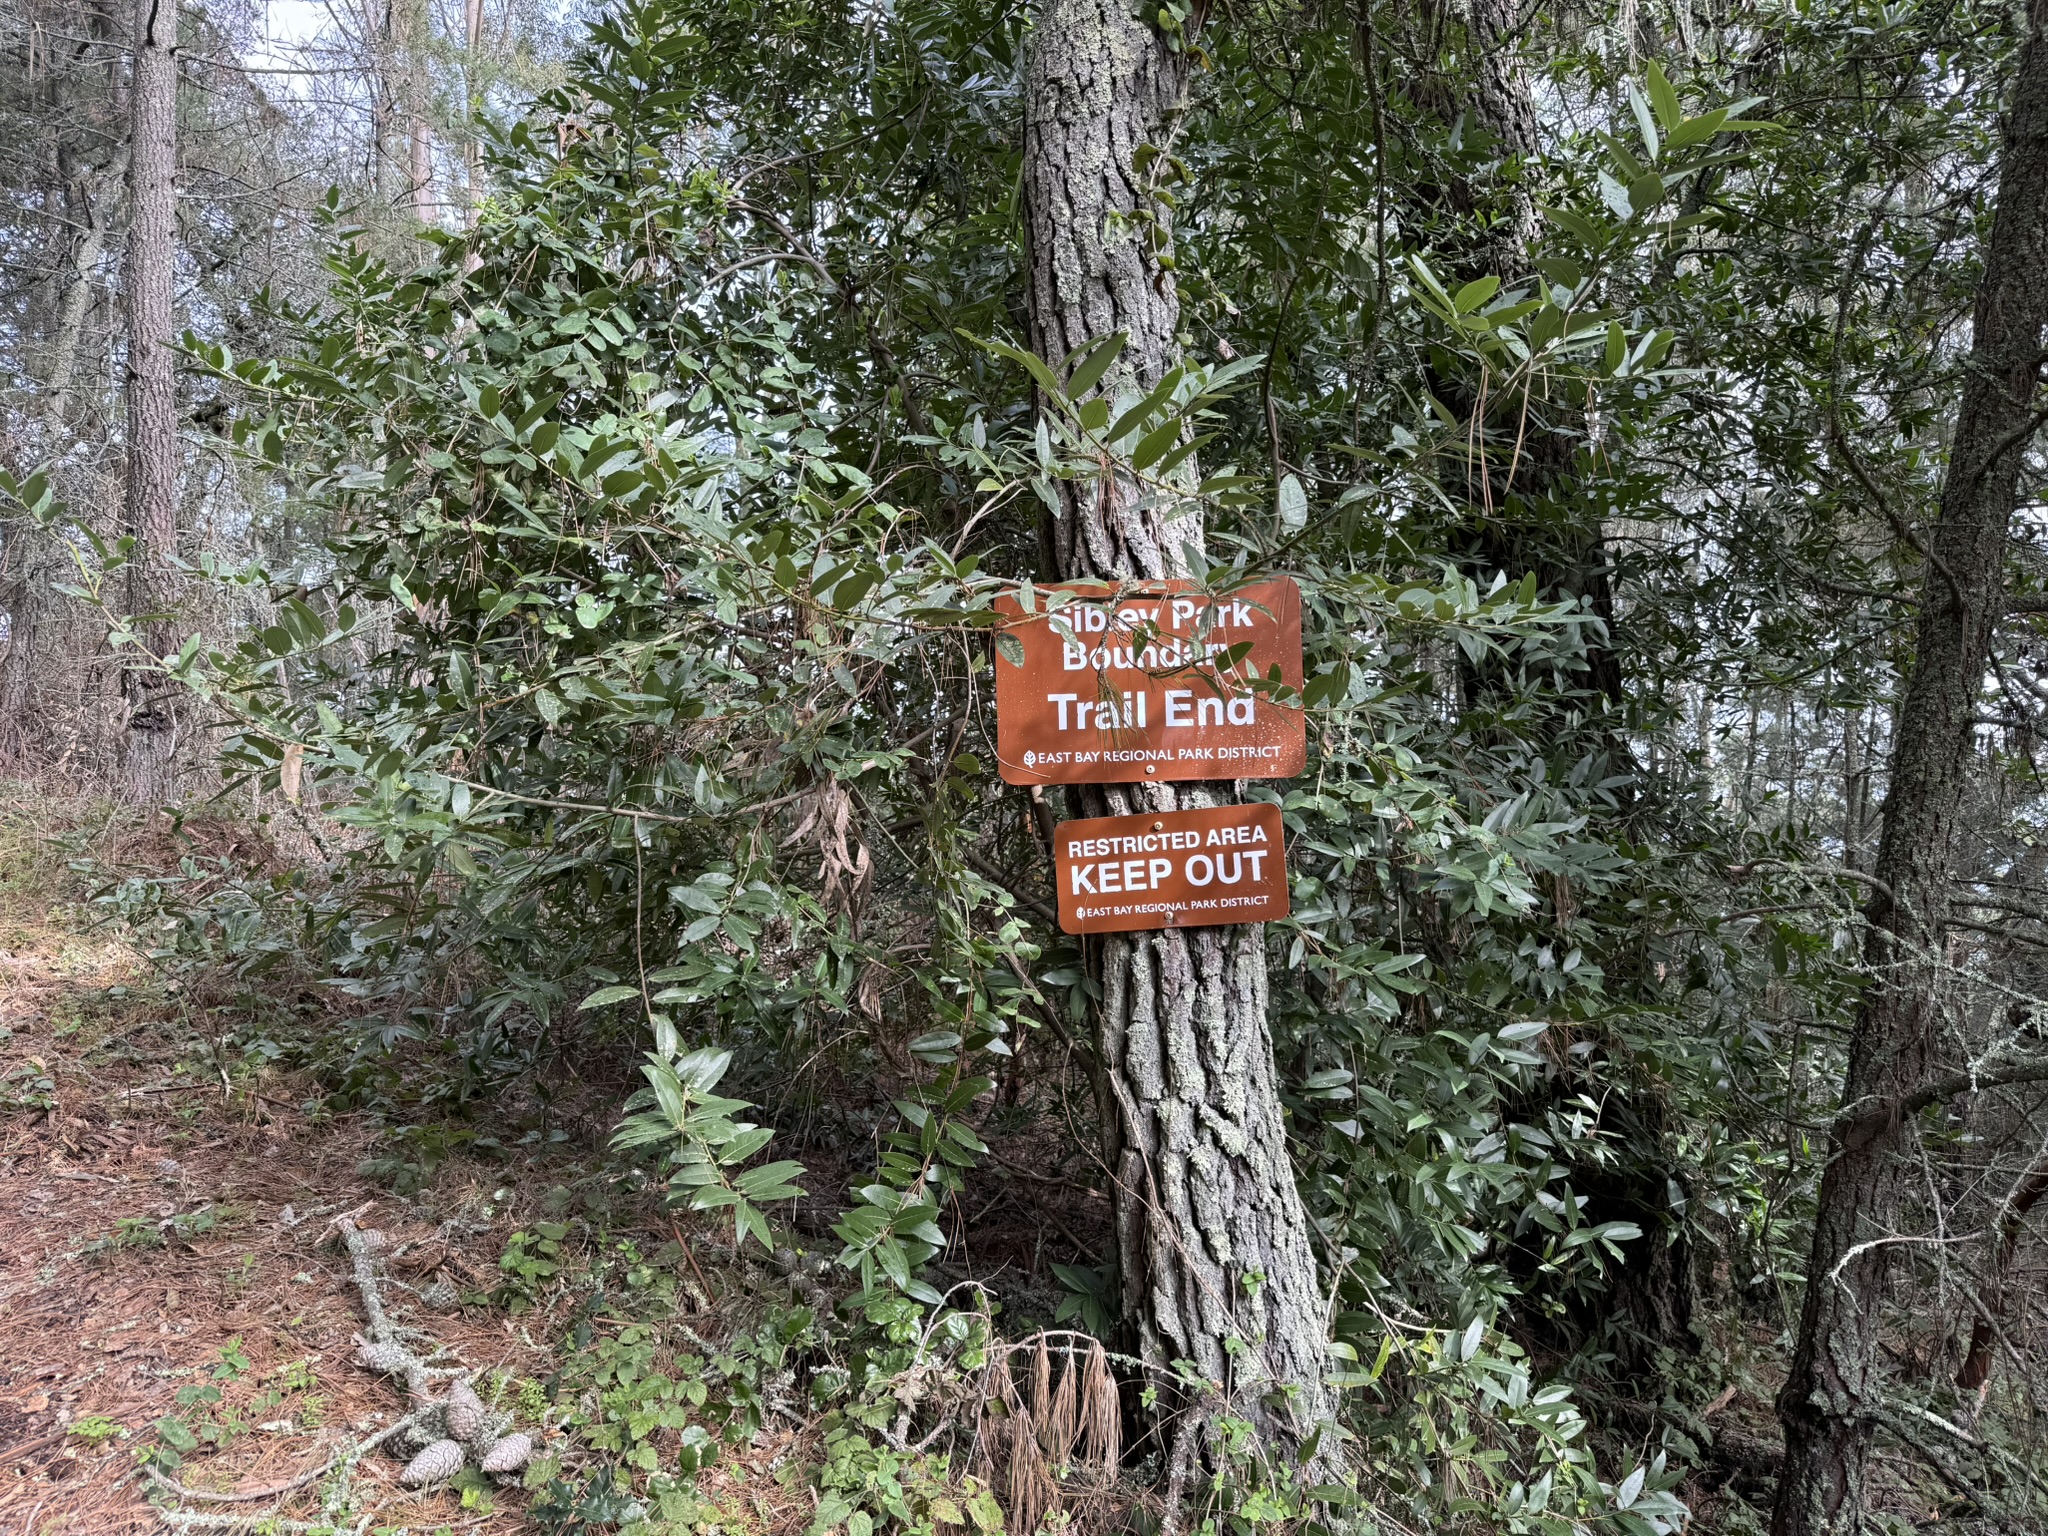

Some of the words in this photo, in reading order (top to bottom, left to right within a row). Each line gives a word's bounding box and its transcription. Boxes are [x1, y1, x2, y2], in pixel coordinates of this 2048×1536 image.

[1048, 601, 1160, 640] Sibey
[1047, 691, 1147, 731] Trail
[1165, 687, 1255, 727] End
[1038, 752, 1072, 764] EAST
[1075, 751, 1100, 763] BAY
[1103, 749, 1175, 762] REGIONAL
[1178, 748, 1213, 760] PARK
[1218, 745, 1282, 758] DISTRICT
[1068, 831, 1201, 859] RESTRICTED
[1206, 825, 1268, 846] AREA
[1071, 858, 1173, 896] KEEP
[1185, 850, 1268, 887] OUT
[1087, 907, 1111, 917] EAST
[1113, 906, 1133, 915] BAY
[1135, 901, 1188, 913] REGIONAL
[1191, 899, 1218, 909] PARK
[1221, 895, 1269, 908] DISTRICT
